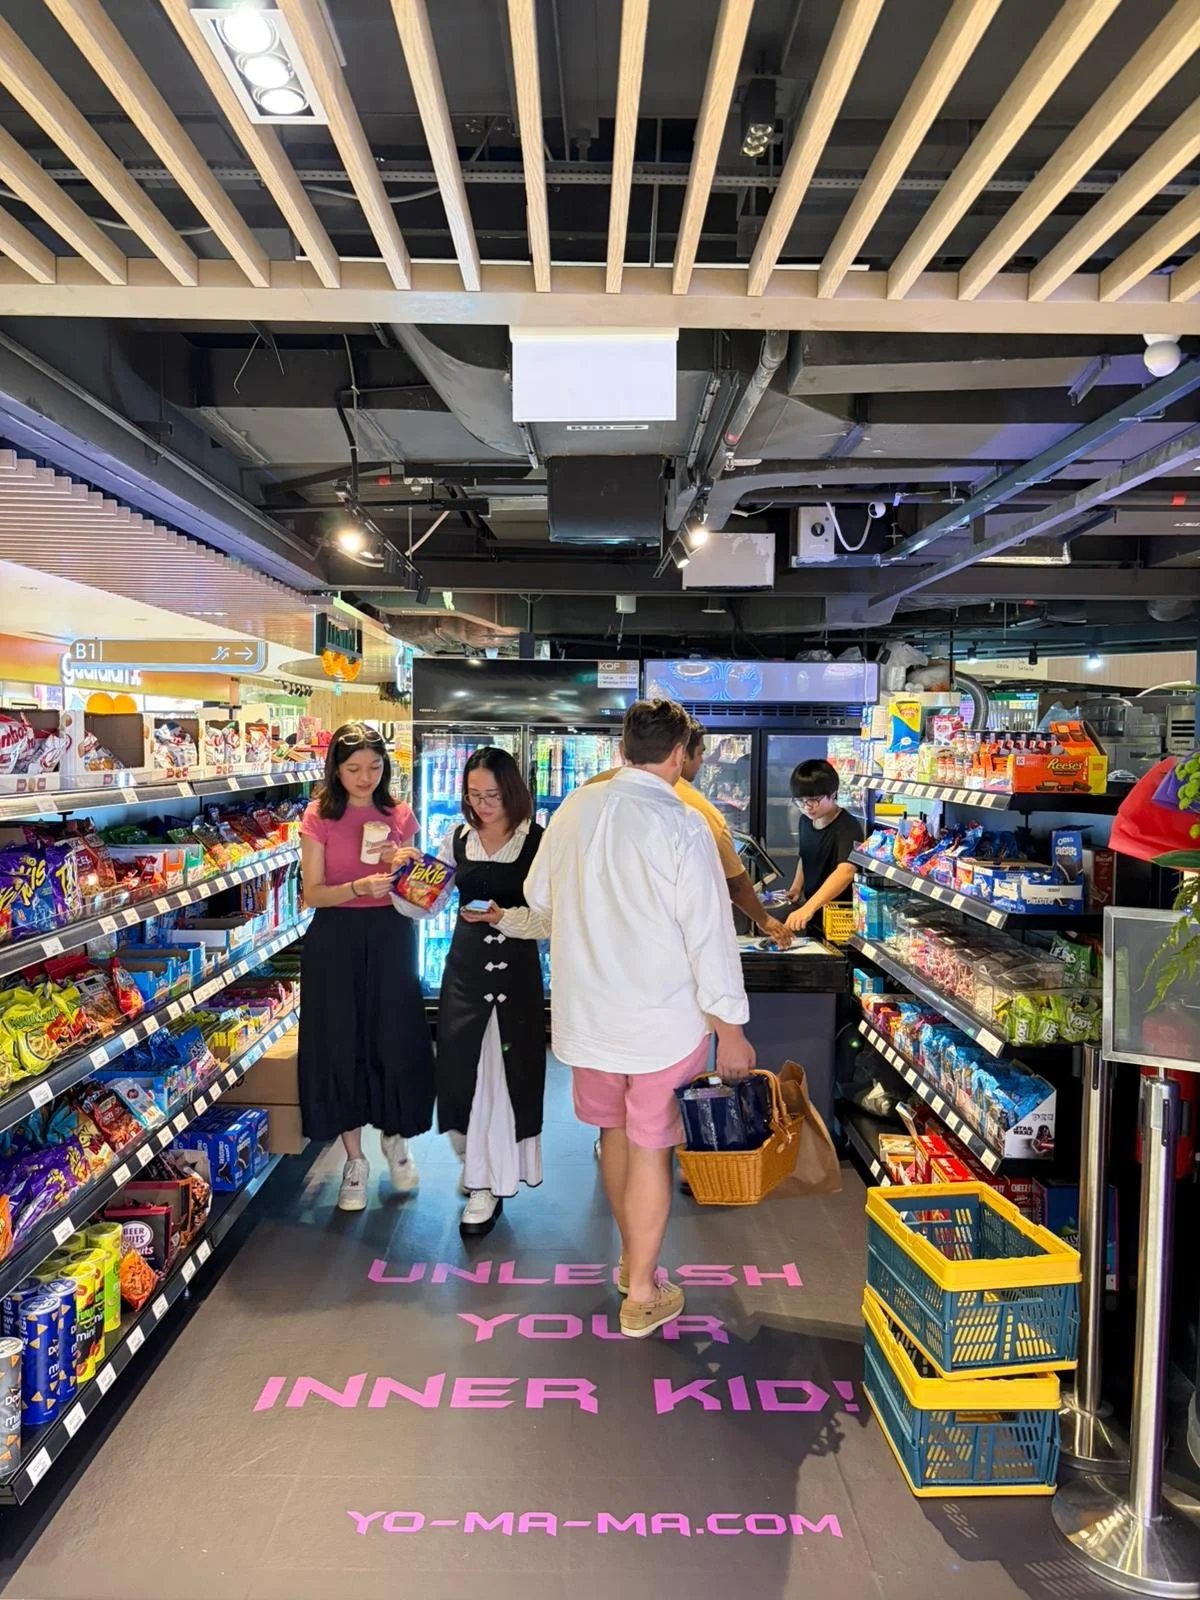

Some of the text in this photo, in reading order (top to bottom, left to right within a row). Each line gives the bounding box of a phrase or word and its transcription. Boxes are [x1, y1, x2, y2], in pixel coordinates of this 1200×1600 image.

[75, 643, 96, 660] B1
[406, 861, 449, 886] Takis
[123, 1228, 145, 1236] BEER
[252, 1372, 862, 1416] INNER KID!
[347, 1510, 844, 1539] YO-MA-MA.COM
